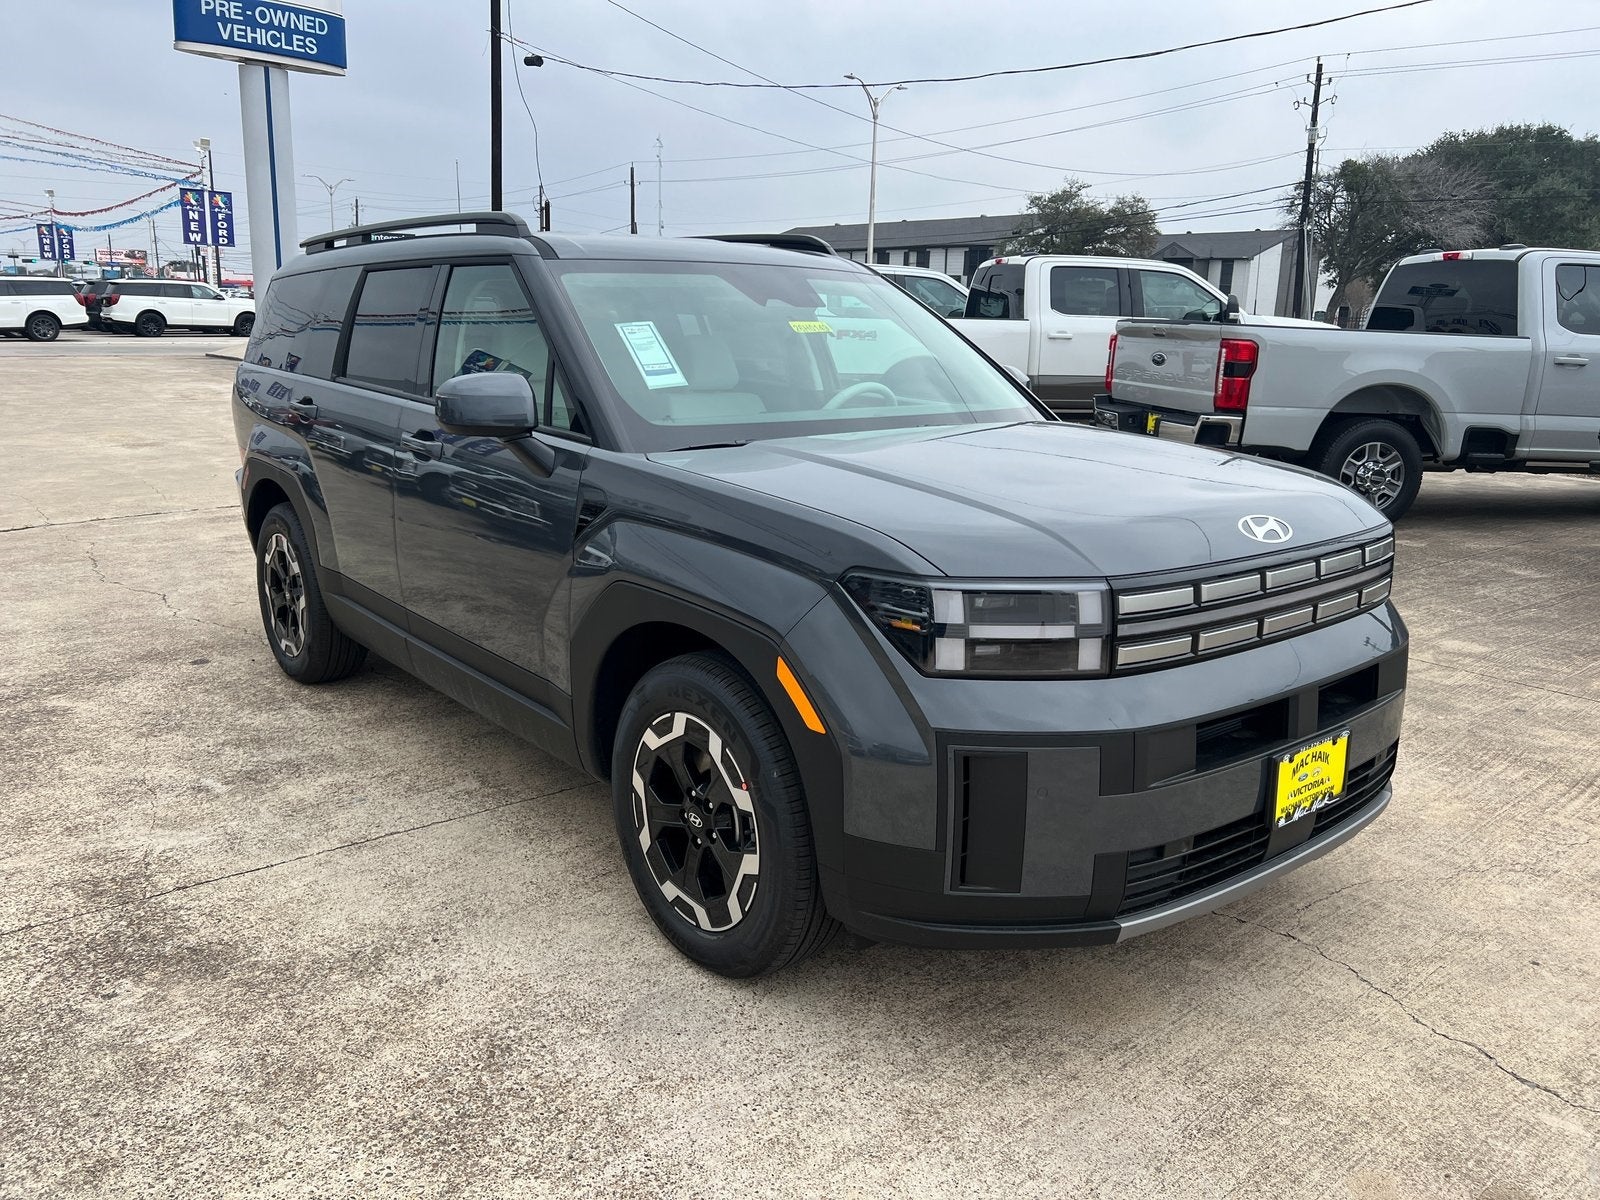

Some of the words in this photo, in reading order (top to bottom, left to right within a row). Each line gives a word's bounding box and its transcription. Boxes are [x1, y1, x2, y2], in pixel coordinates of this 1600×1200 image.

[217, 22, 318, 55] VEHICLES
[188, 210, 202, 242] NEW
[217, 213, 228, 245] FORD
[42, 237, 53, 259] NEW
[62, 238, 71, 259] FORD
[1117, 368, 1161, 382] SUPER
[1164, 372, 1209, 386] DUTY
[1291, 753, 1310, 780] MAC
[1311, 750, 1330, 764] HAIK
[1293, 777, 1324, 798] VICTORIA
